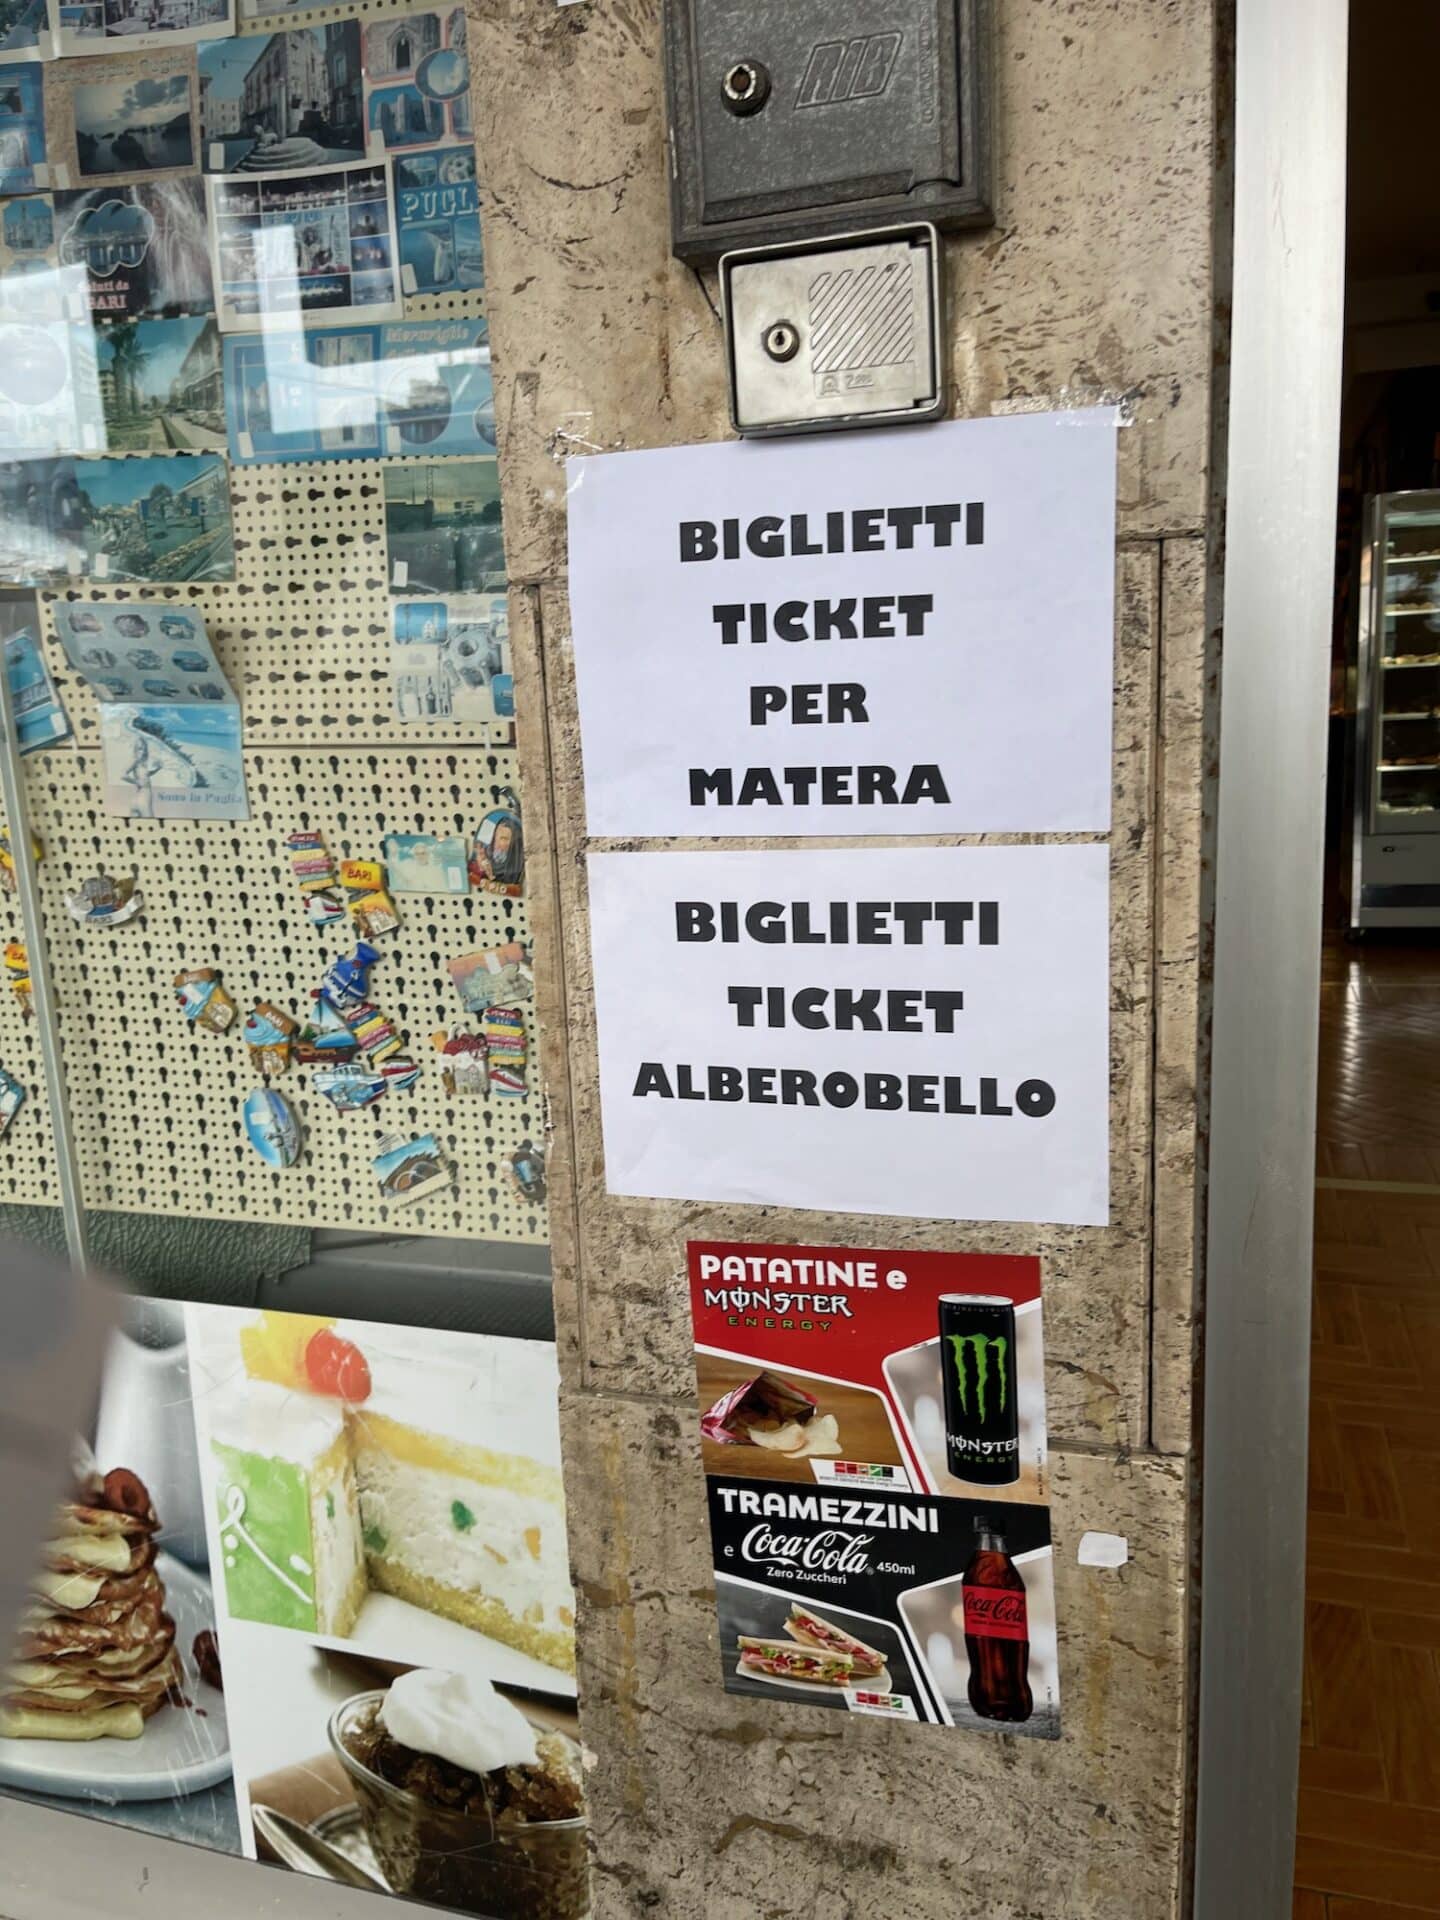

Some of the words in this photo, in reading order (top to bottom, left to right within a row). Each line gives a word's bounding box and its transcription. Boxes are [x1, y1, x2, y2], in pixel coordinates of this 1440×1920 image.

[796, 31, 902, 109] RIB
[402, 187, 480, 221] PUGL
[680, 502, 984, 562] BIGLIETTI
[713, 594, 932, 644] TICKET
[751, 683, 869, 725] PER
[689, 765, 950, 805] MATERA
[347, 869, 372, 881] BARI
[676, 902, 998, 945] BIGLIETTI
[728, 987, 963, 1033] TICKET
[633, 1063, 1055, 1117] ALBEROBELLO
[700, 1254, 878, 1289] PATATINE
[886, 1269, 908, 1290] e
[728, 1315, 832, 1332] ENERGY
[717, 1487, 939, 1533] TRAMEZZINI
[723, 1544, 735, 1558] e
[741, 1523, 875, 1574] Coca-Cola
[876, 1561, 916, 1576] 450ml
[766, 1566, 795, 1580] Zero
[795, 1569, 847, 1586] Zuccheri
